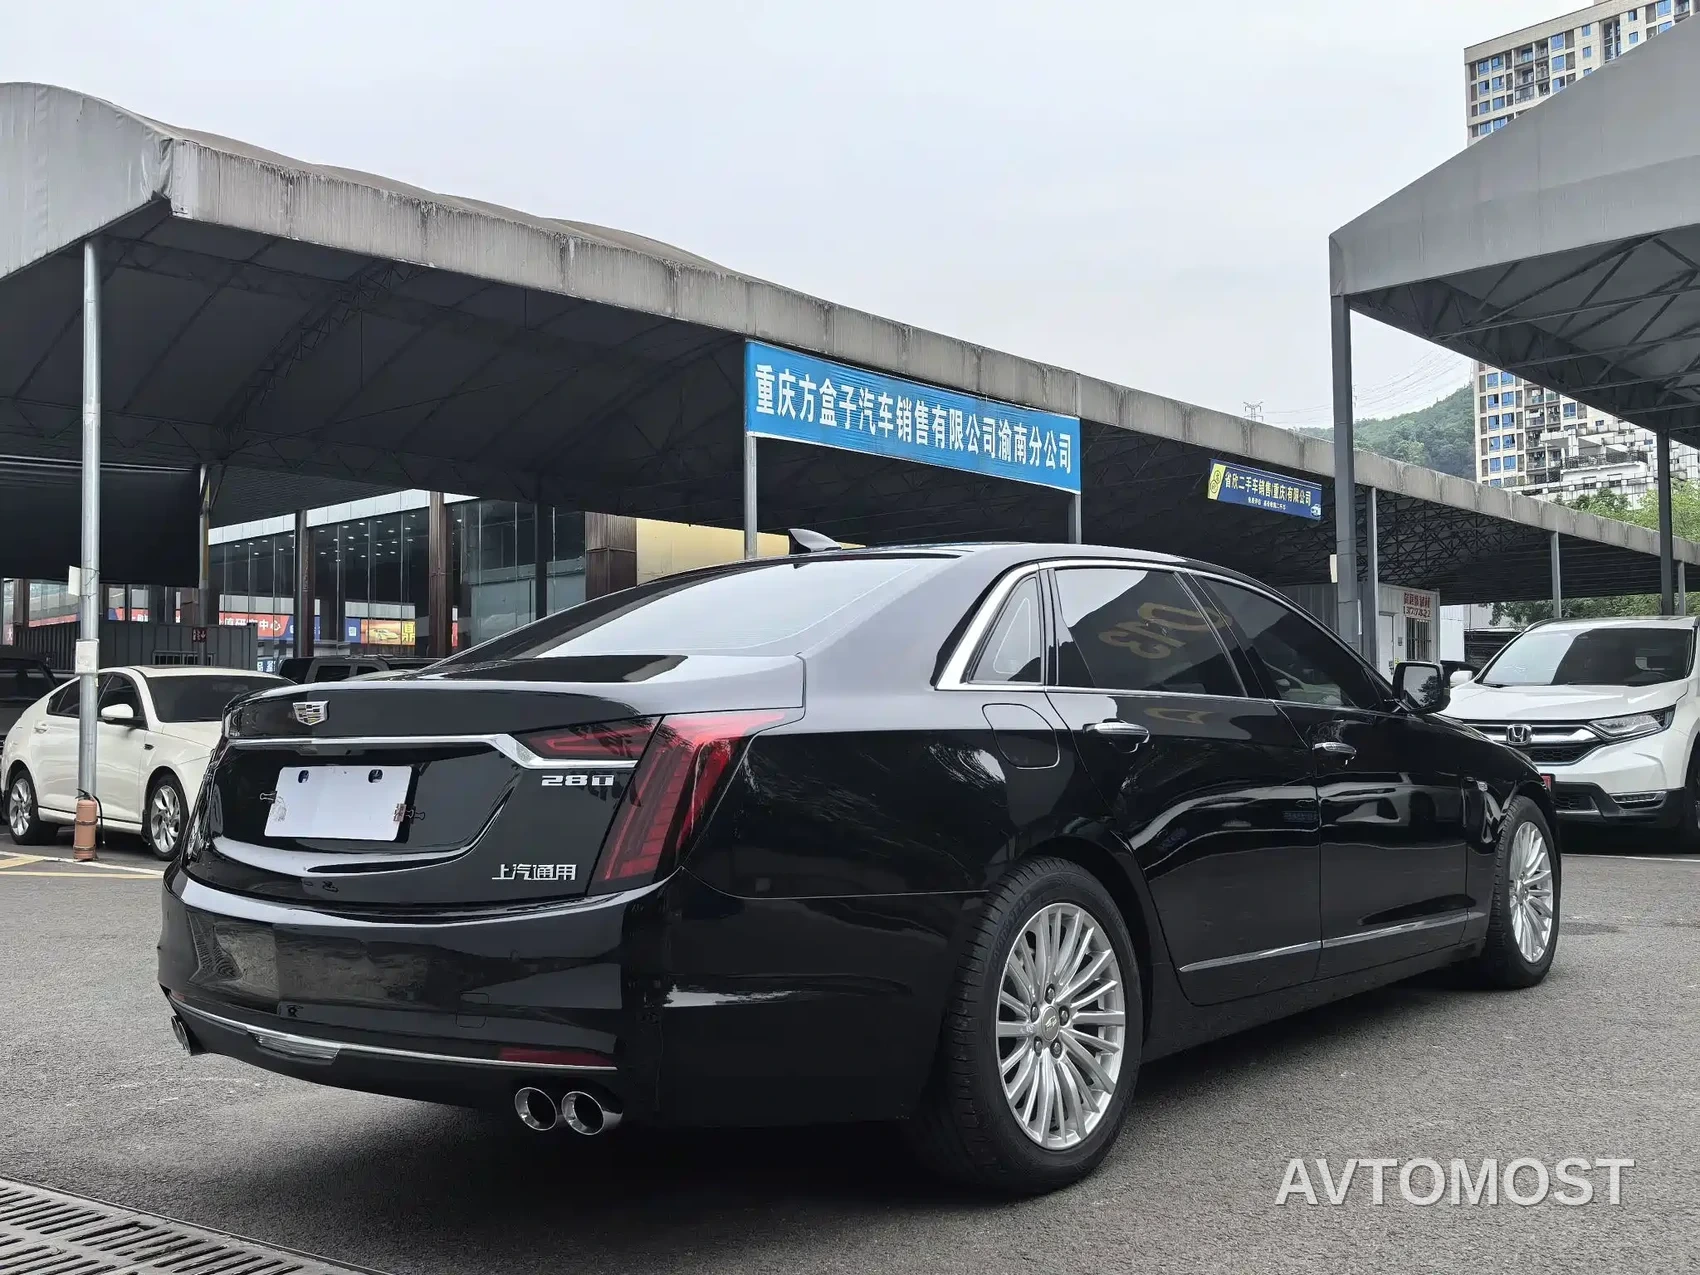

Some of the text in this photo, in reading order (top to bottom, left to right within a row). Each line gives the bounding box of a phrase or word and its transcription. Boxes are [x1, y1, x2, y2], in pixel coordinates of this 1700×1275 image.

[754, 364, 1072, 474] 重庆方盒子汽车销售有限公司渝南分公司
[541, 774, 614, 786] 28T
[491, 863, 577, 881] 上汽通用
